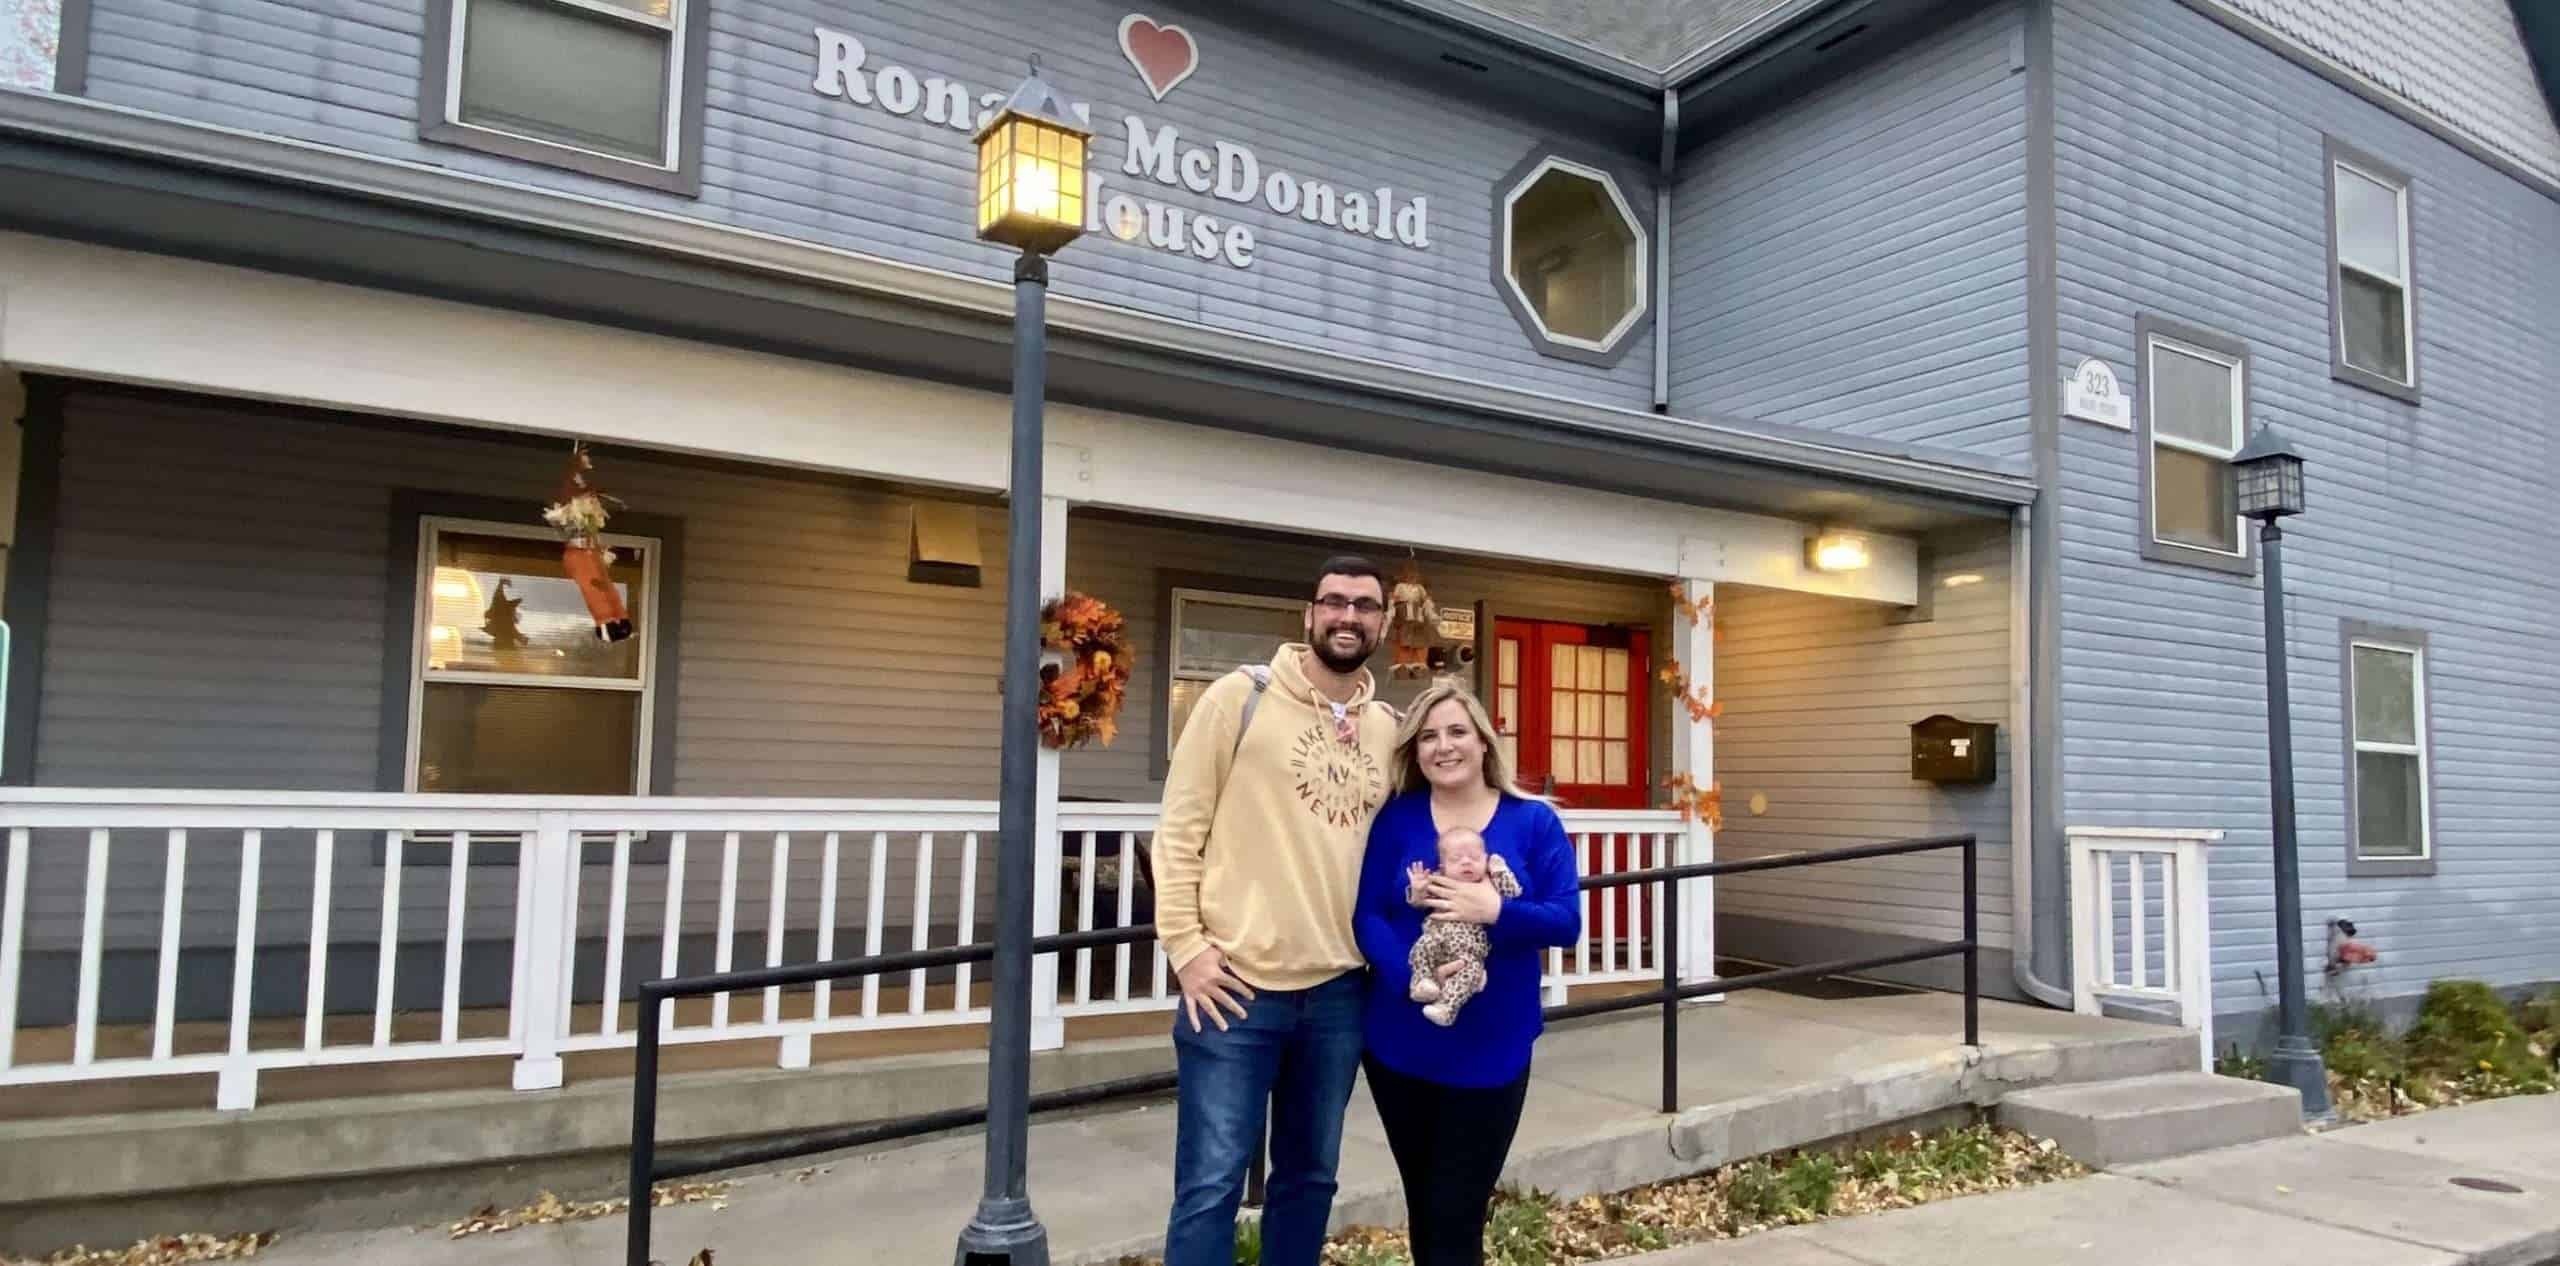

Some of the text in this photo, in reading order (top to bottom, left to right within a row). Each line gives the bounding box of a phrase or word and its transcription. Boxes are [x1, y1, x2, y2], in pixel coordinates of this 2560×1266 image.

[813, 27, 1430, 249] Rona McDonald
[2086, 370, 2110, 398] 323
